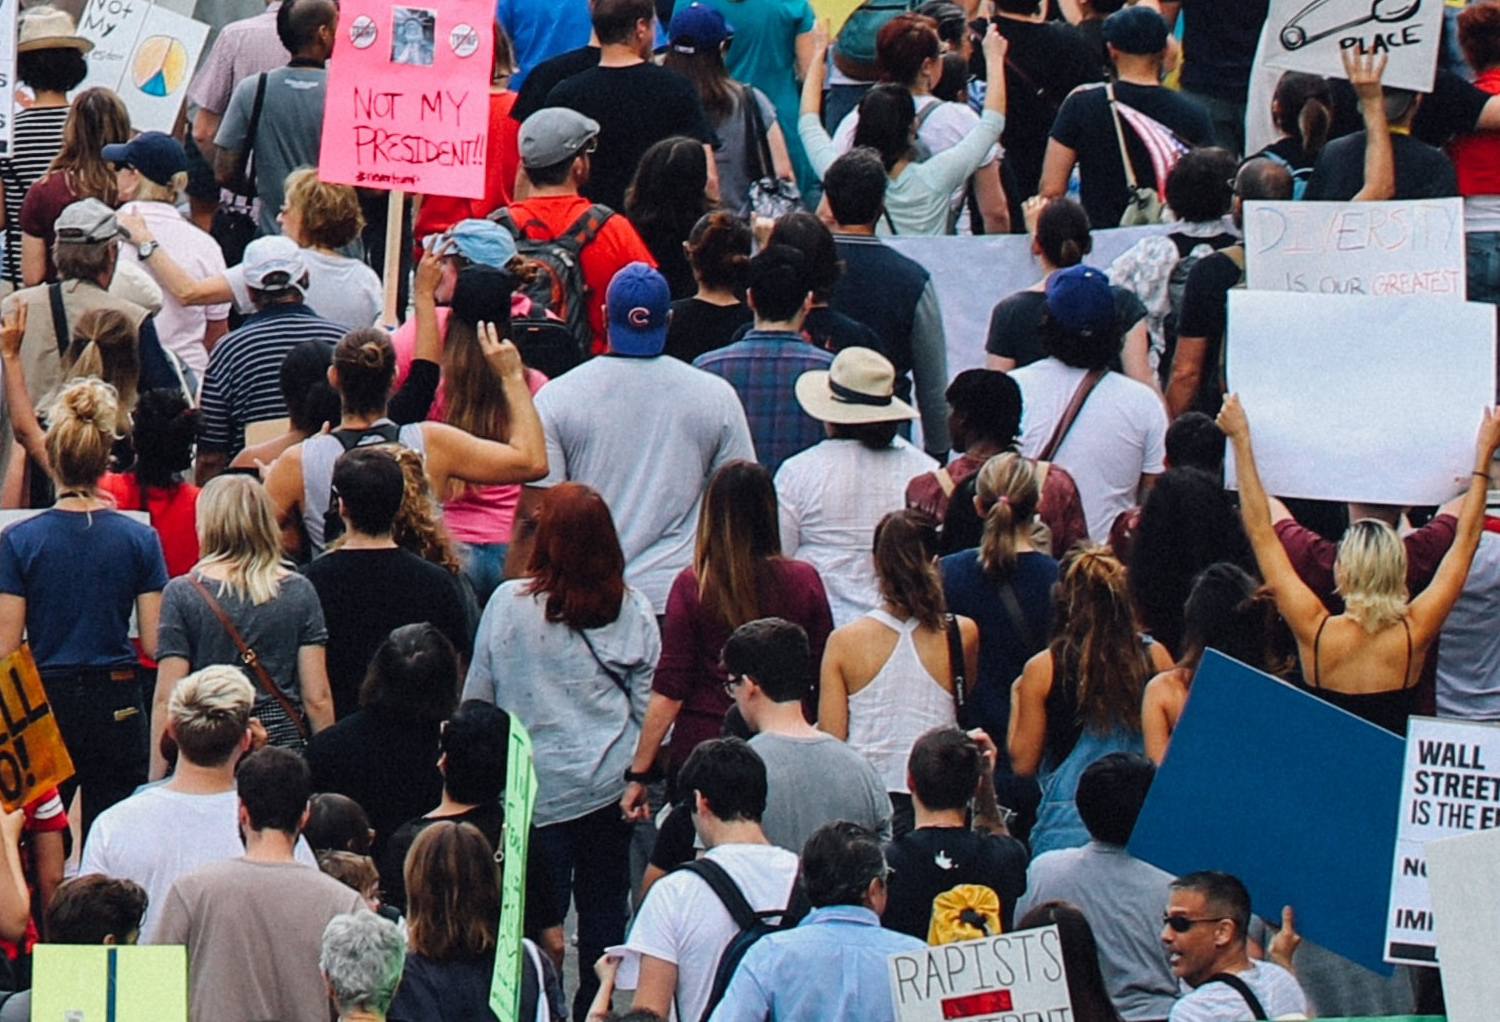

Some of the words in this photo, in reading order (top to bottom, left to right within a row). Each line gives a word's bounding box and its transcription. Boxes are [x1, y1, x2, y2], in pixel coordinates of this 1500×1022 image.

[1340, 23, 1423, 54] PLACE
[353, 85, 403, 121] NOT
[420, 89, 470, 123] MY
[355, 125, 486, 166] PRESIDENT!!
[1255, 204, 1455, 255] DIVERSITY
[1320, 278, 1366, 295] OUR
[1372, 270, 1460, 297] GREATEST
[1418, 742, 1485, 772] WALL
[1414, 772, 1500, 802] STREET
[896, 931, 1064, 1004] RAPISTS
